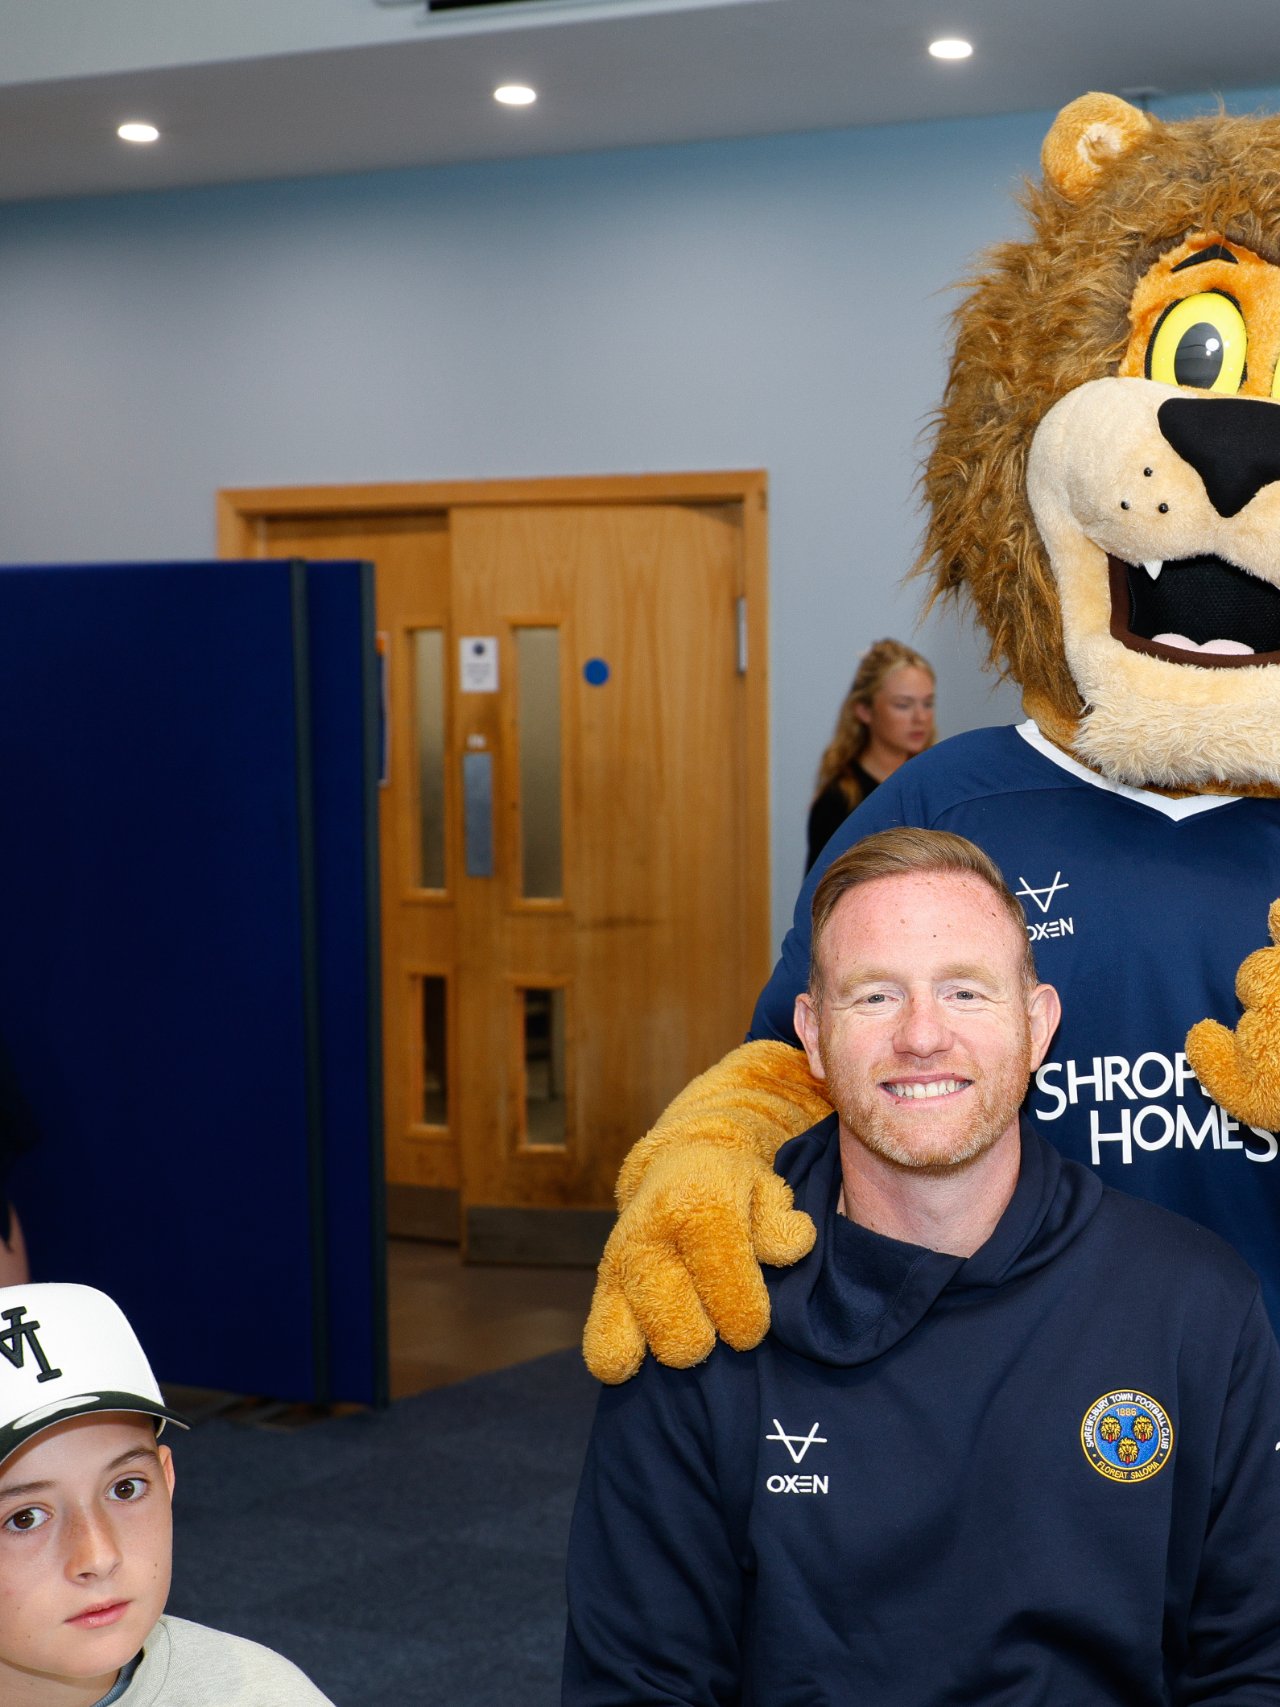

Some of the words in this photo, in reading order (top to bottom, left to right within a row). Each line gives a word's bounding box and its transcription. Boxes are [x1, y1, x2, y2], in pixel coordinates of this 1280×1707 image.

[1035, 1051, 1213, 1121] SHROP
[1090, 1104, 1279, 1165] HOMES
[1083, 1397, 1109, 1448] SHREWSBURY
[1109, 1392, 1133, 1403] TOWN
[1135, 1395, 1165, 1427] FOOTBALL
[1160, 1427, 1170, 1450] CLUB
[1115, 1407, 1137, 1417] 1886
[766, 1474, 829, 1494] OXEN
[1097, 1460, 1129, 1479] FLOREAT
[1130, 1460, 1160, 1480] SALOPIA
